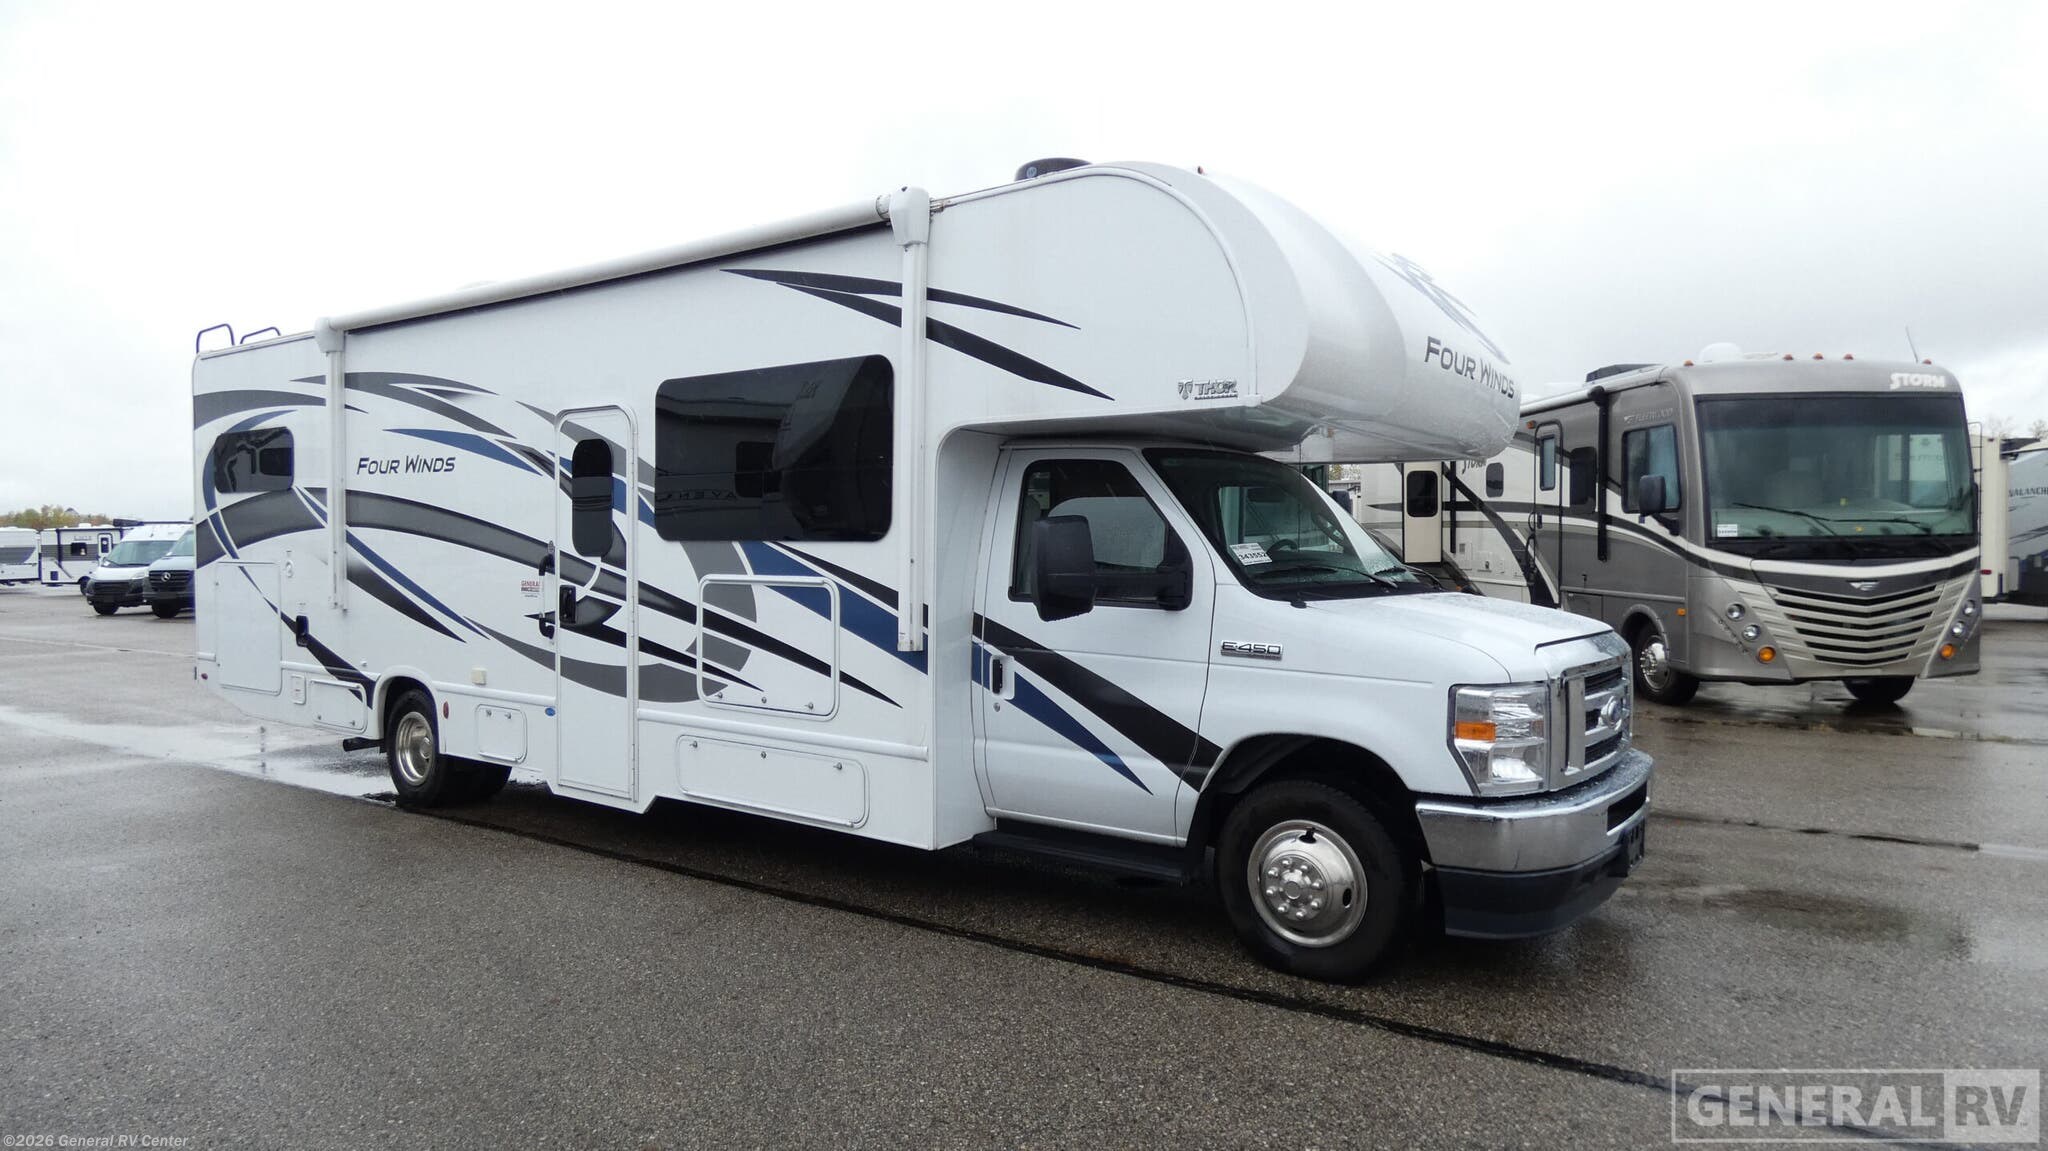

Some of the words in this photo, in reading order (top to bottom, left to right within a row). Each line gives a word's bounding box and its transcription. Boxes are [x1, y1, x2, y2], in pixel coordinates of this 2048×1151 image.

[1424, 335, 1476, 380] FOUR
[1480, 358, 1515, 399] WINDS
[1194, 380, 1237, 396] THOR
[1890, 372, 1945, 390] STORM
[356, 457, 400, 475] FOUR
[405, 454, 456, 474] WINDS
